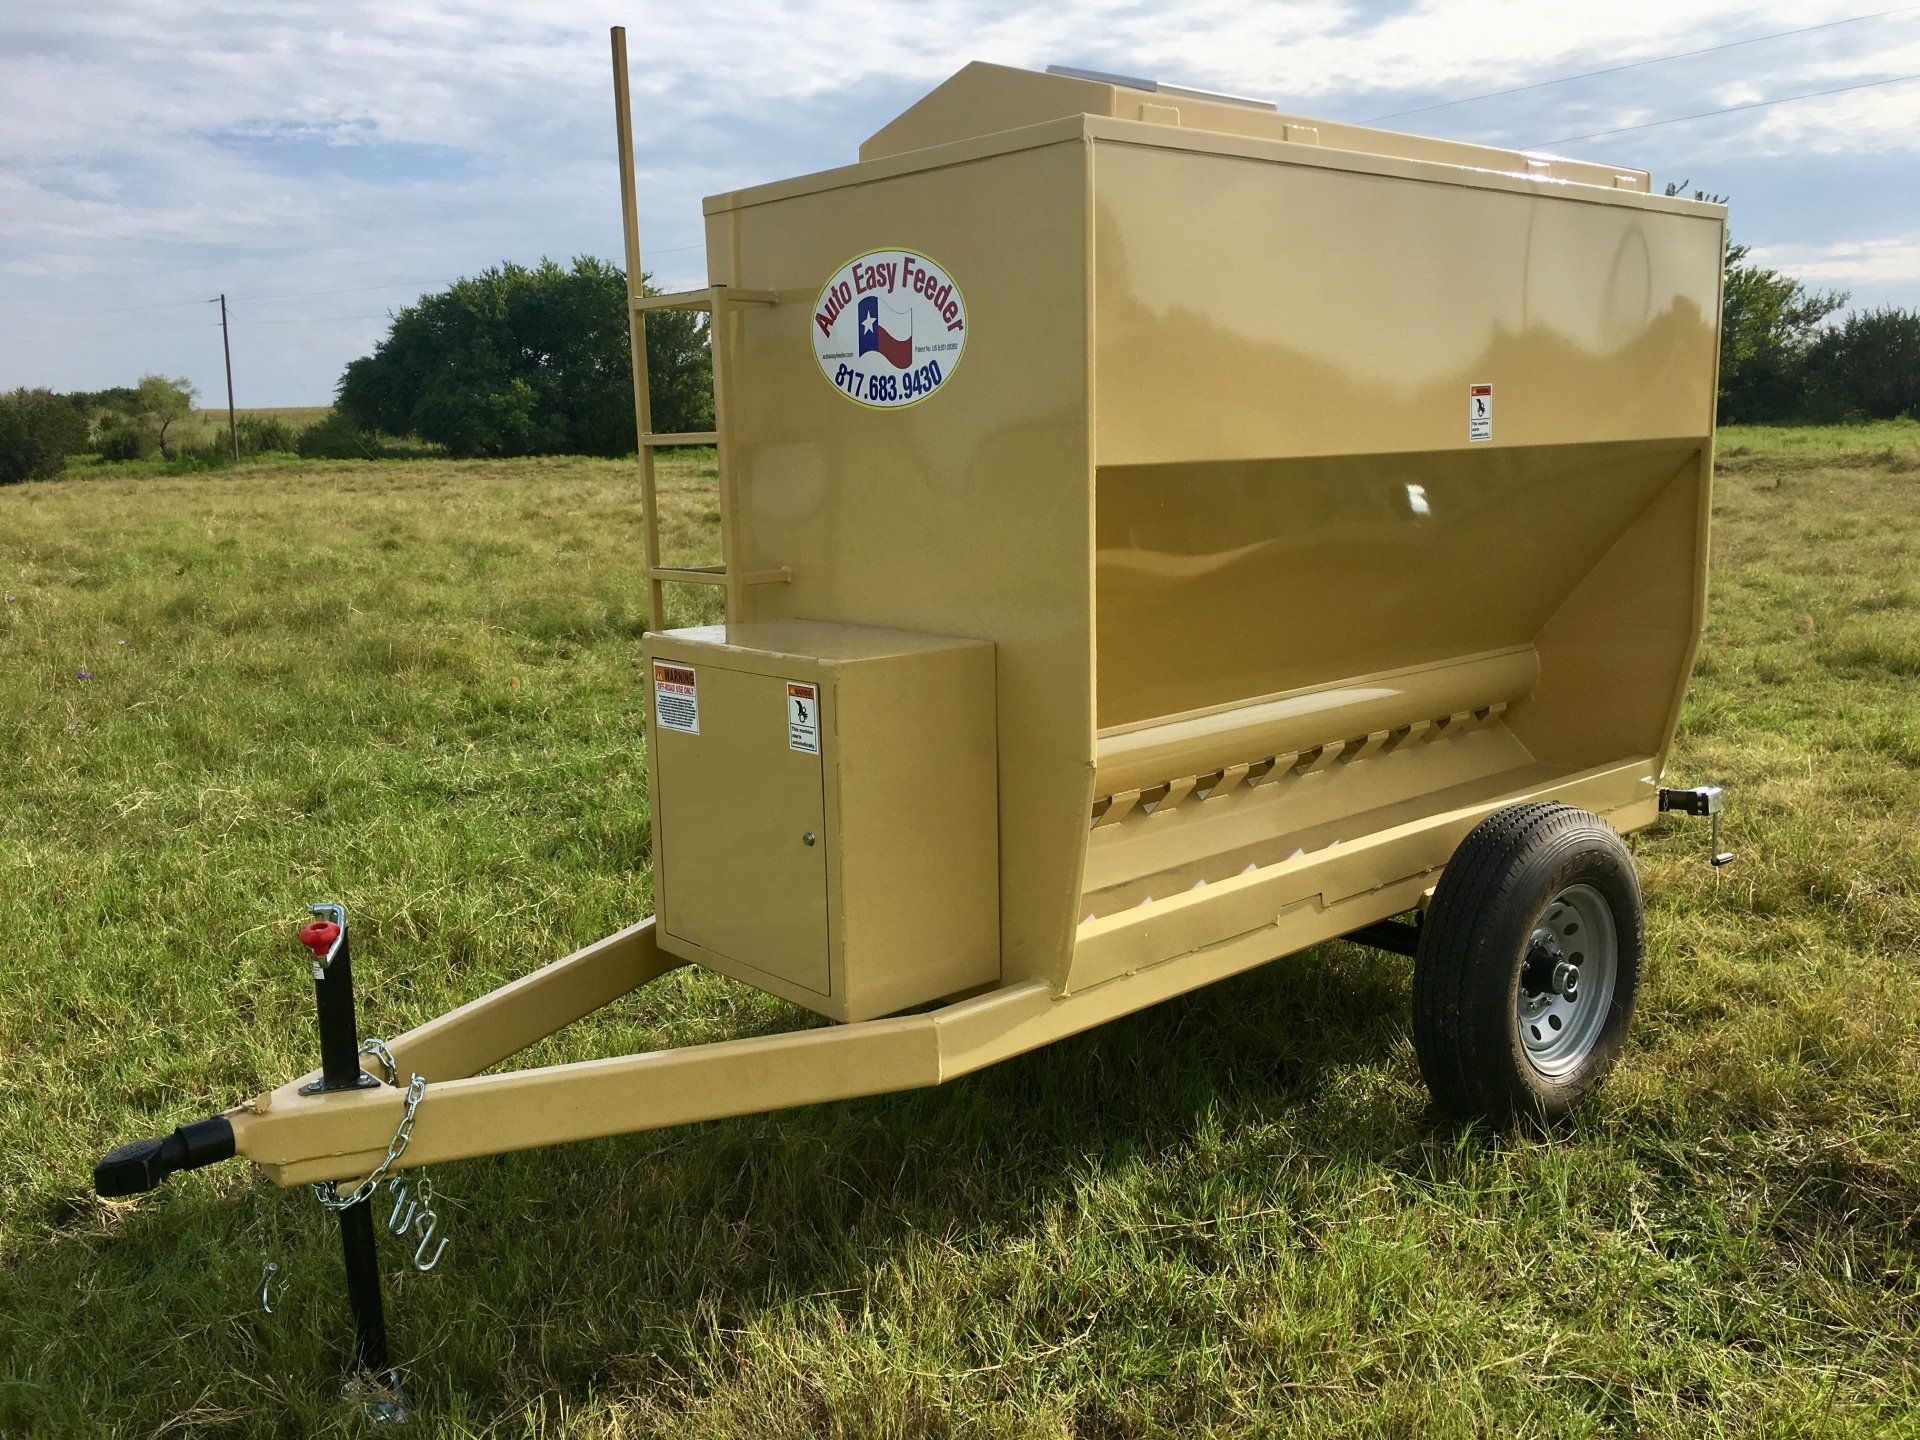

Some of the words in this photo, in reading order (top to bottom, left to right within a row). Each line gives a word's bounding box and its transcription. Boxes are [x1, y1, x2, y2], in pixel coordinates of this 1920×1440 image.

[815, 281, 852, 338] Auto
[852, 262, 897, 294] Easy
[902, 257, 964, 332] Feeder
[835, 360, 942, 401] 817.683.9430
[664, 669, 694, 686] WARNING
[684, 686, 694, 695] ONLY
